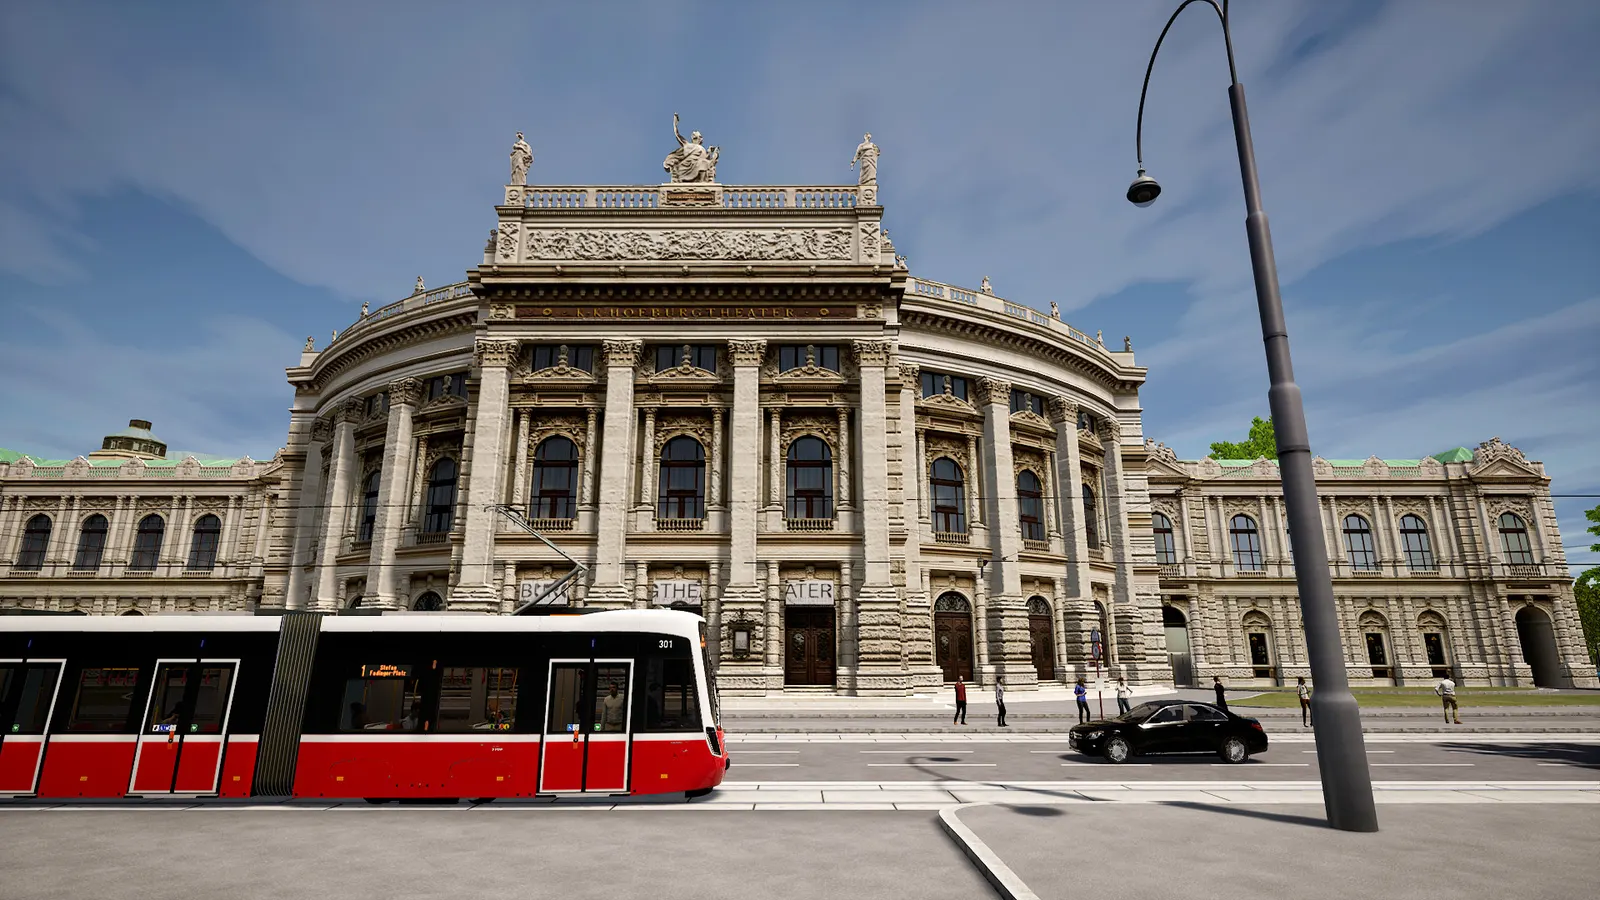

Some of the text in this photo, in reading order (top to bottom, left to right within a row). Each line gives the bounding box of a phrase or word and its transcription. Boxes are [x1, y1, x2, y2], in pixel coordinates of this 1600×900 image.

[786, 583, 832, 598] ATER
[658, 640, 673, 648] 301
[361, 665, 366, 677] 1
